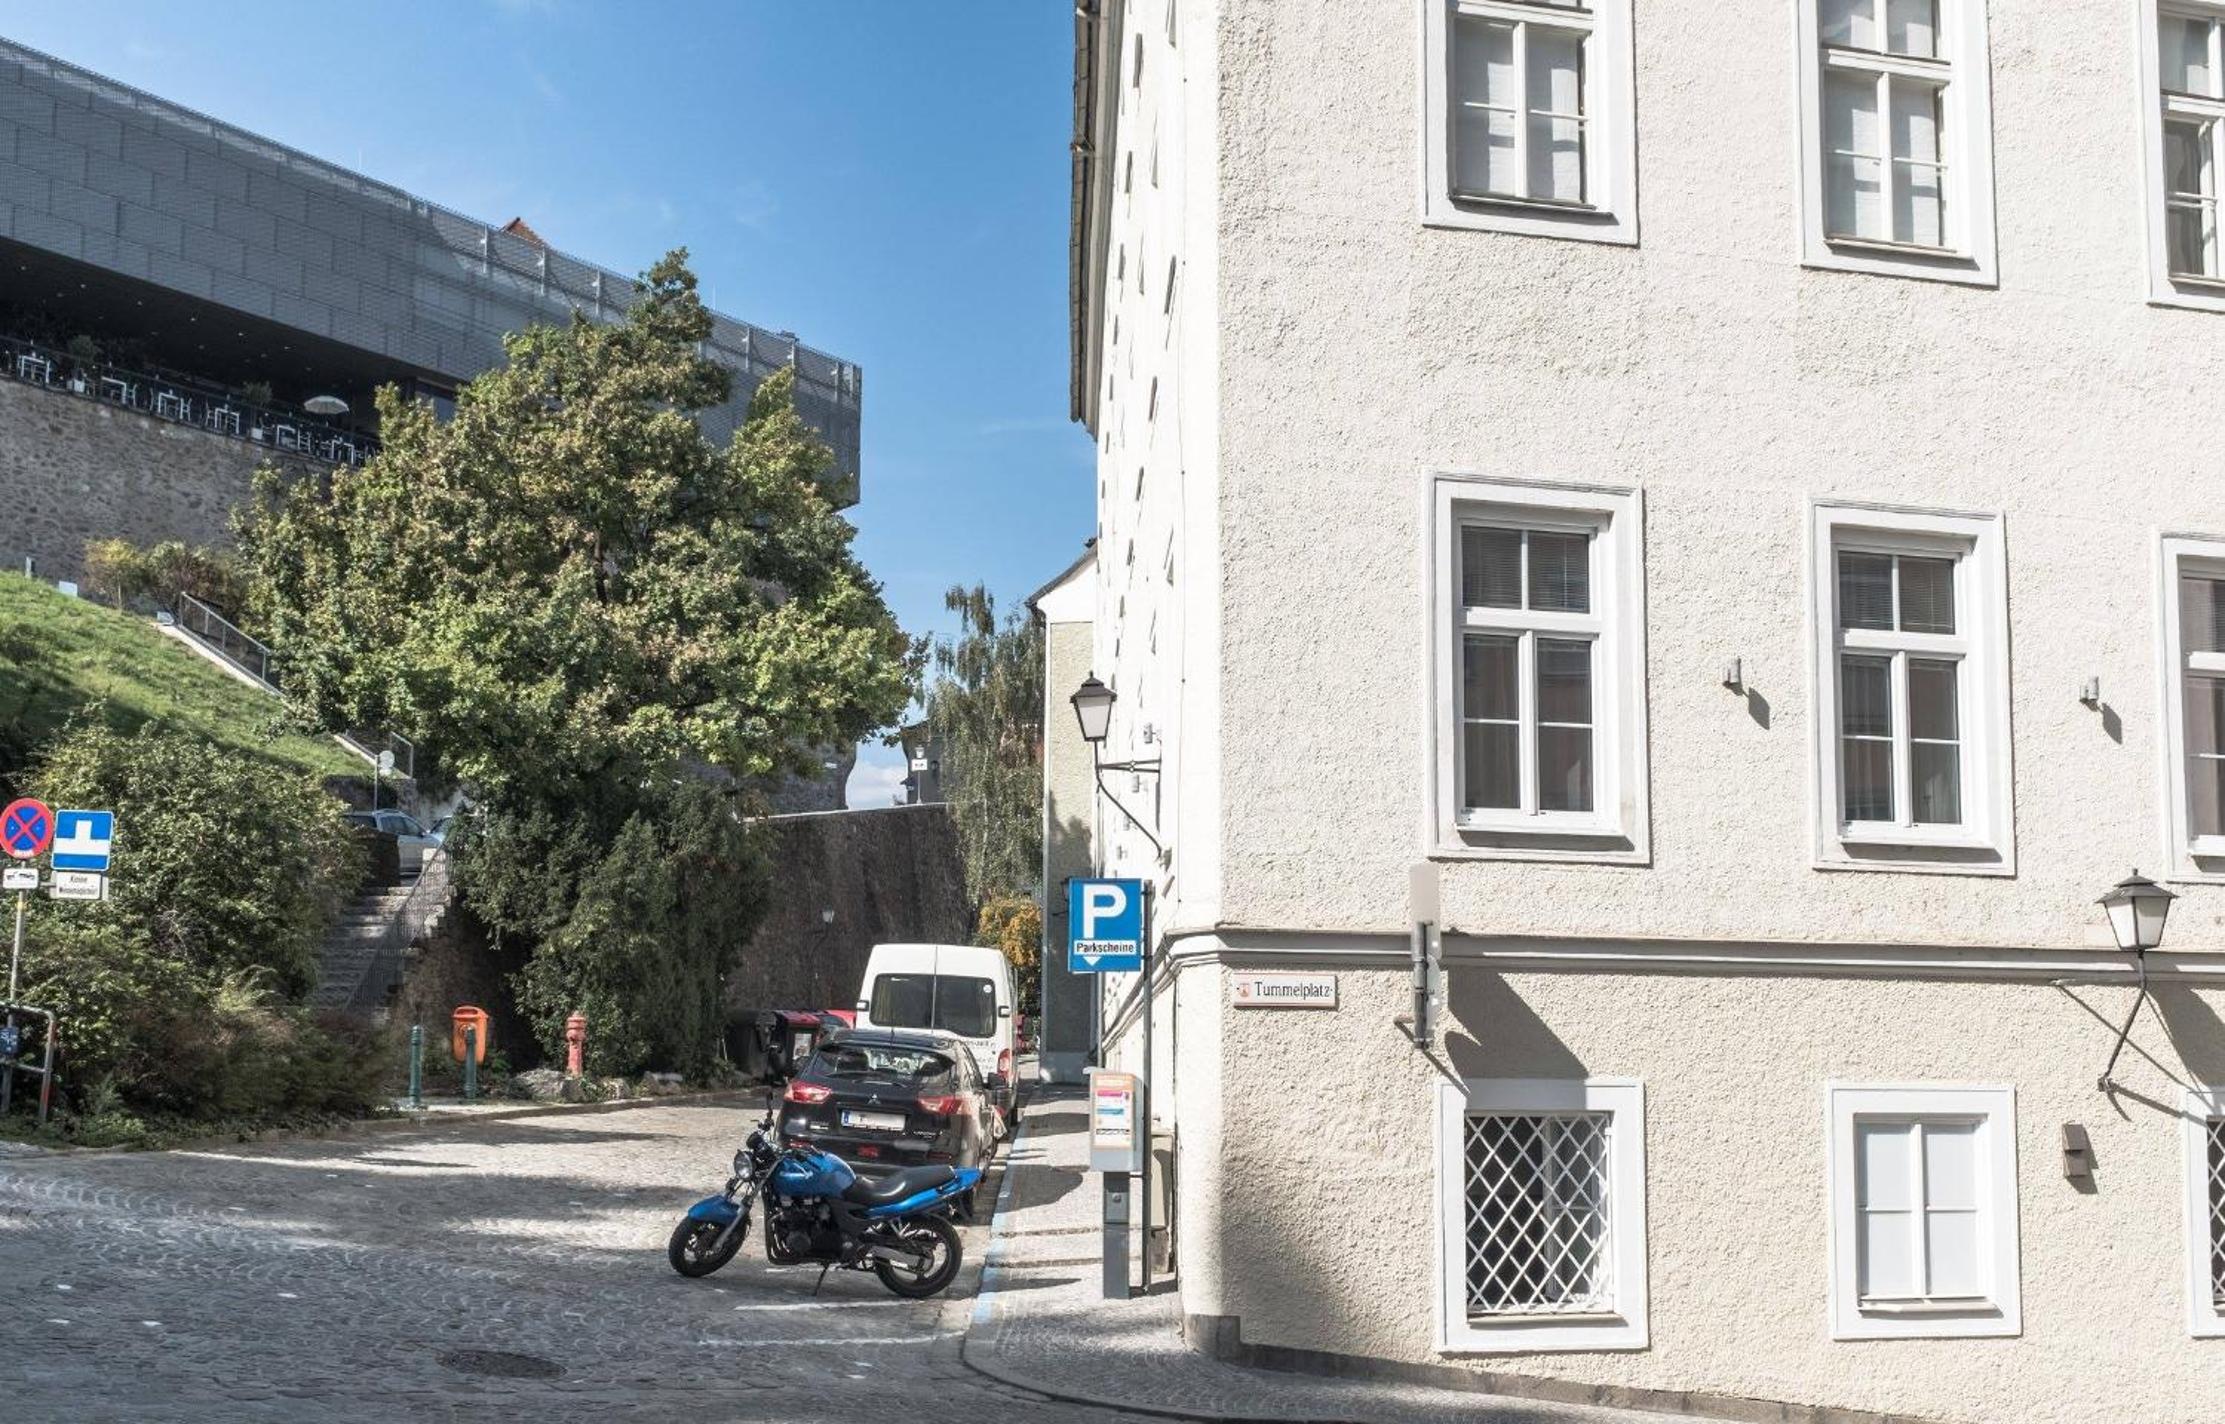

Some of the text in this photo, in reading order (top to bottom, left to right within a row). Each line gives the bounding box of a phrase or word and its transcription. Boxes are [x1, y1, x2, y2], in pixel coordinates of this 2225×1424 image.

[1083, 884, 1127, 939] P
[1076, 942, 1134, 953] Parkscheine
[1254, 981, 1330, 1000] Tummelplatz
